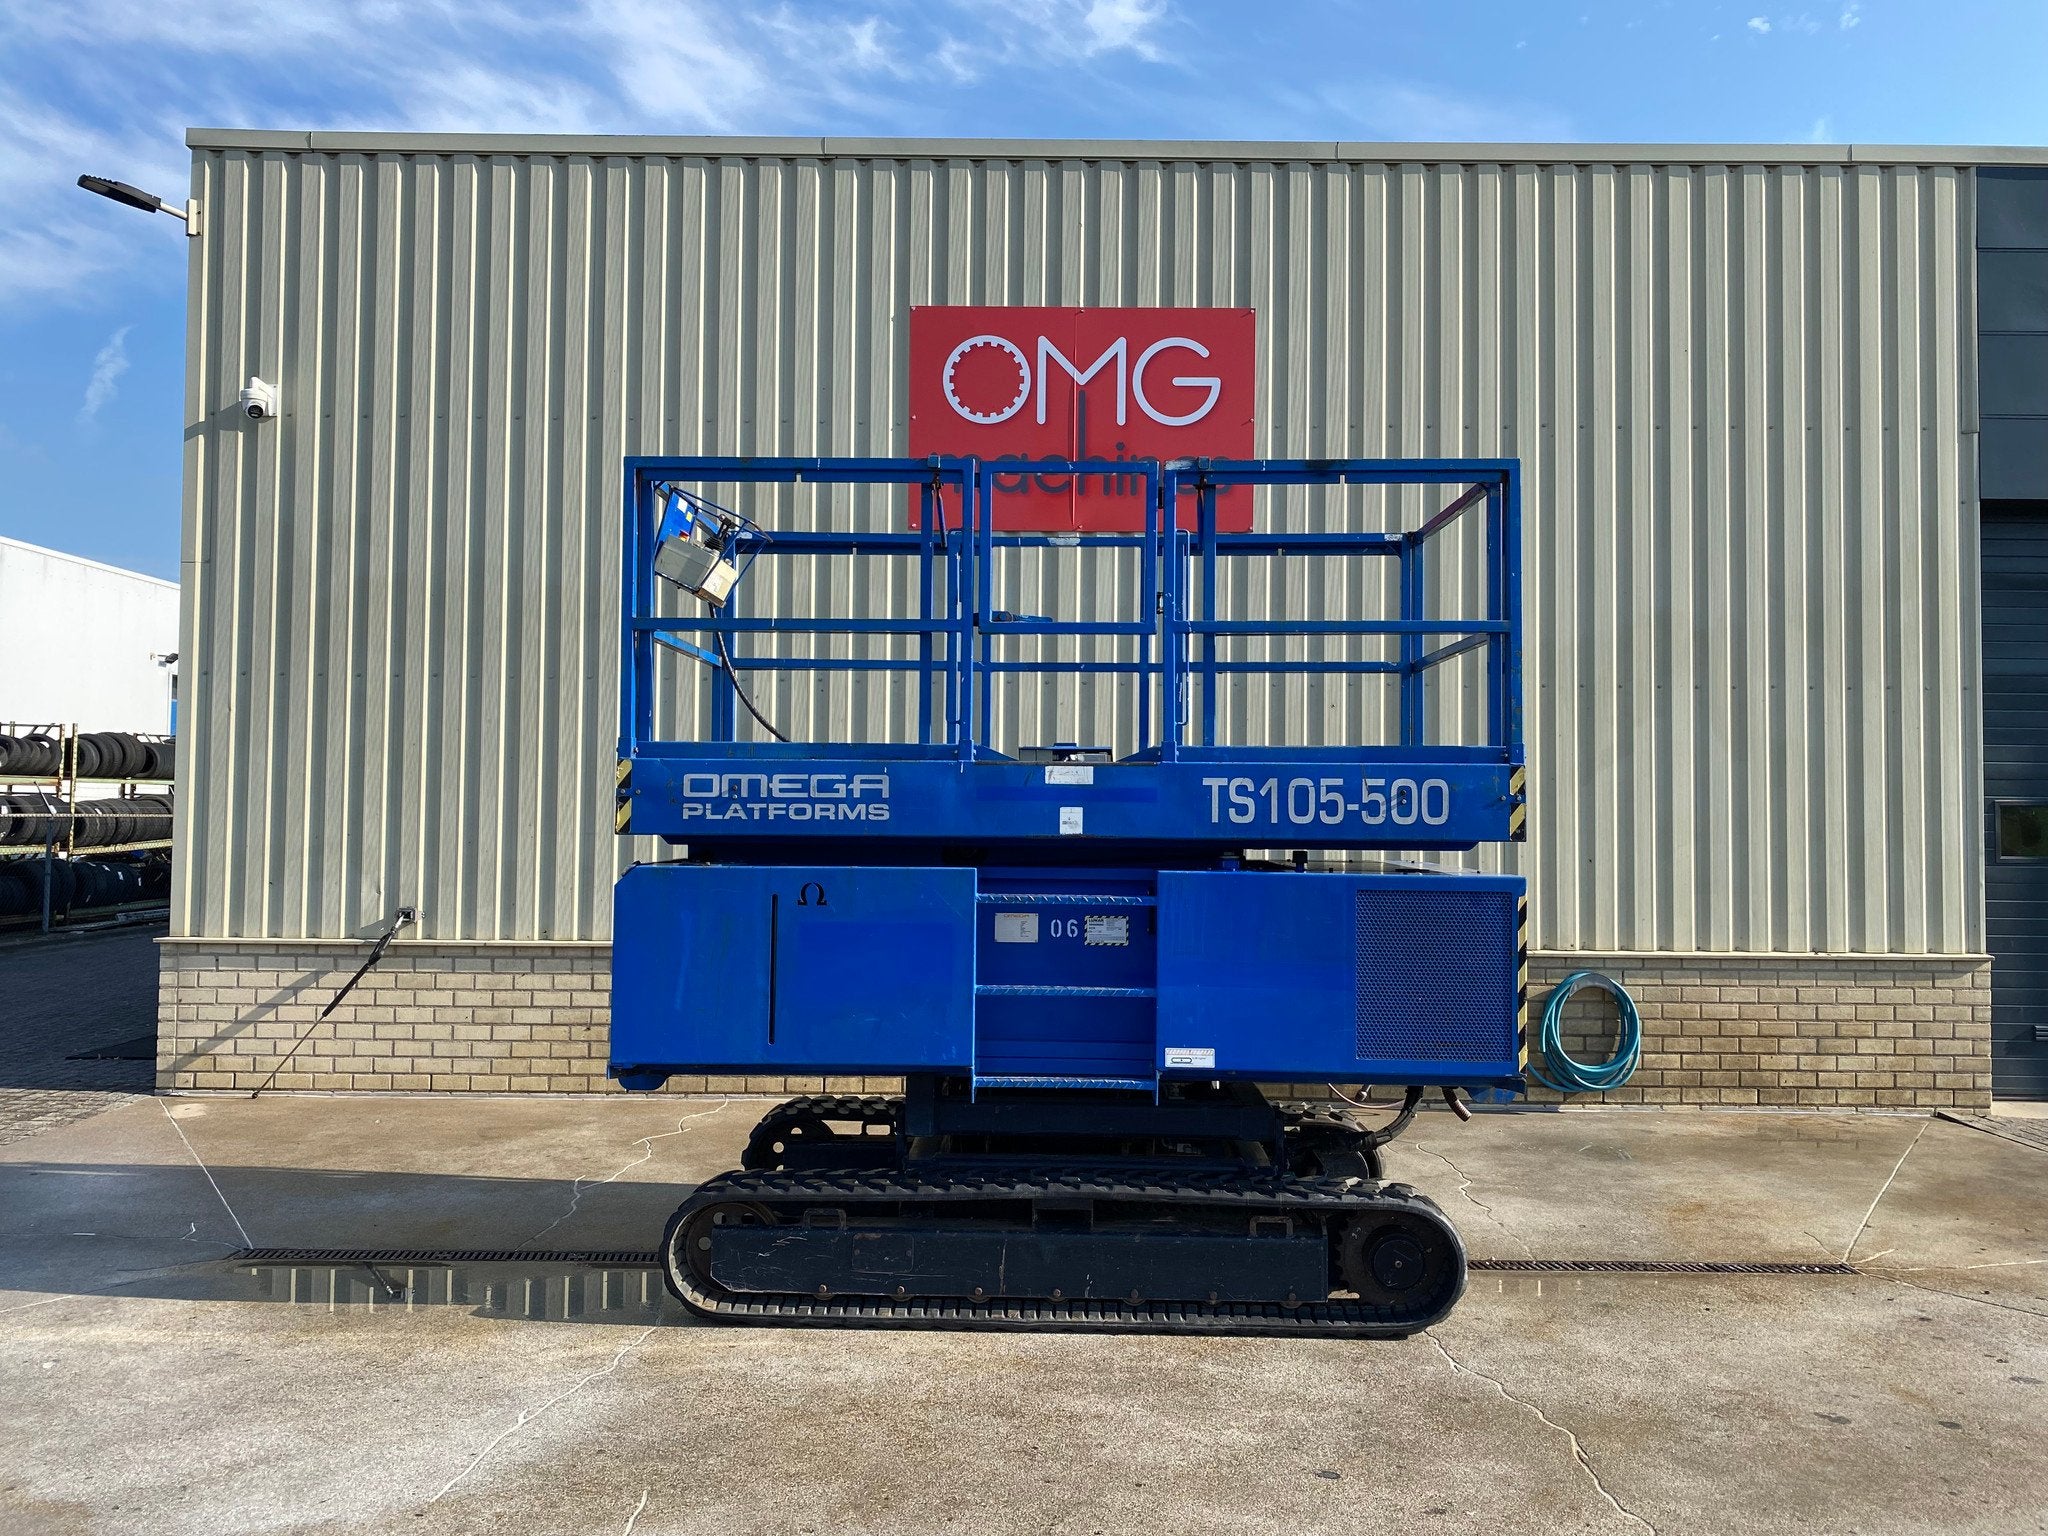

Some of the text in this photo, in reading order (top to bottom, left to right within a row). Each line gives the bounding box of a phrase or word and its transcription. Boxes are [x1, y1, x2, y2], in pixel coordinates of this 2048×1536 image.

[943, 335, 1221, 426] OMG
[683, 774, 889, 798] OMEGA
[1202, 778, 1449, 825] TS105-500
[682, 803, 890, 820] PLATFORMS
